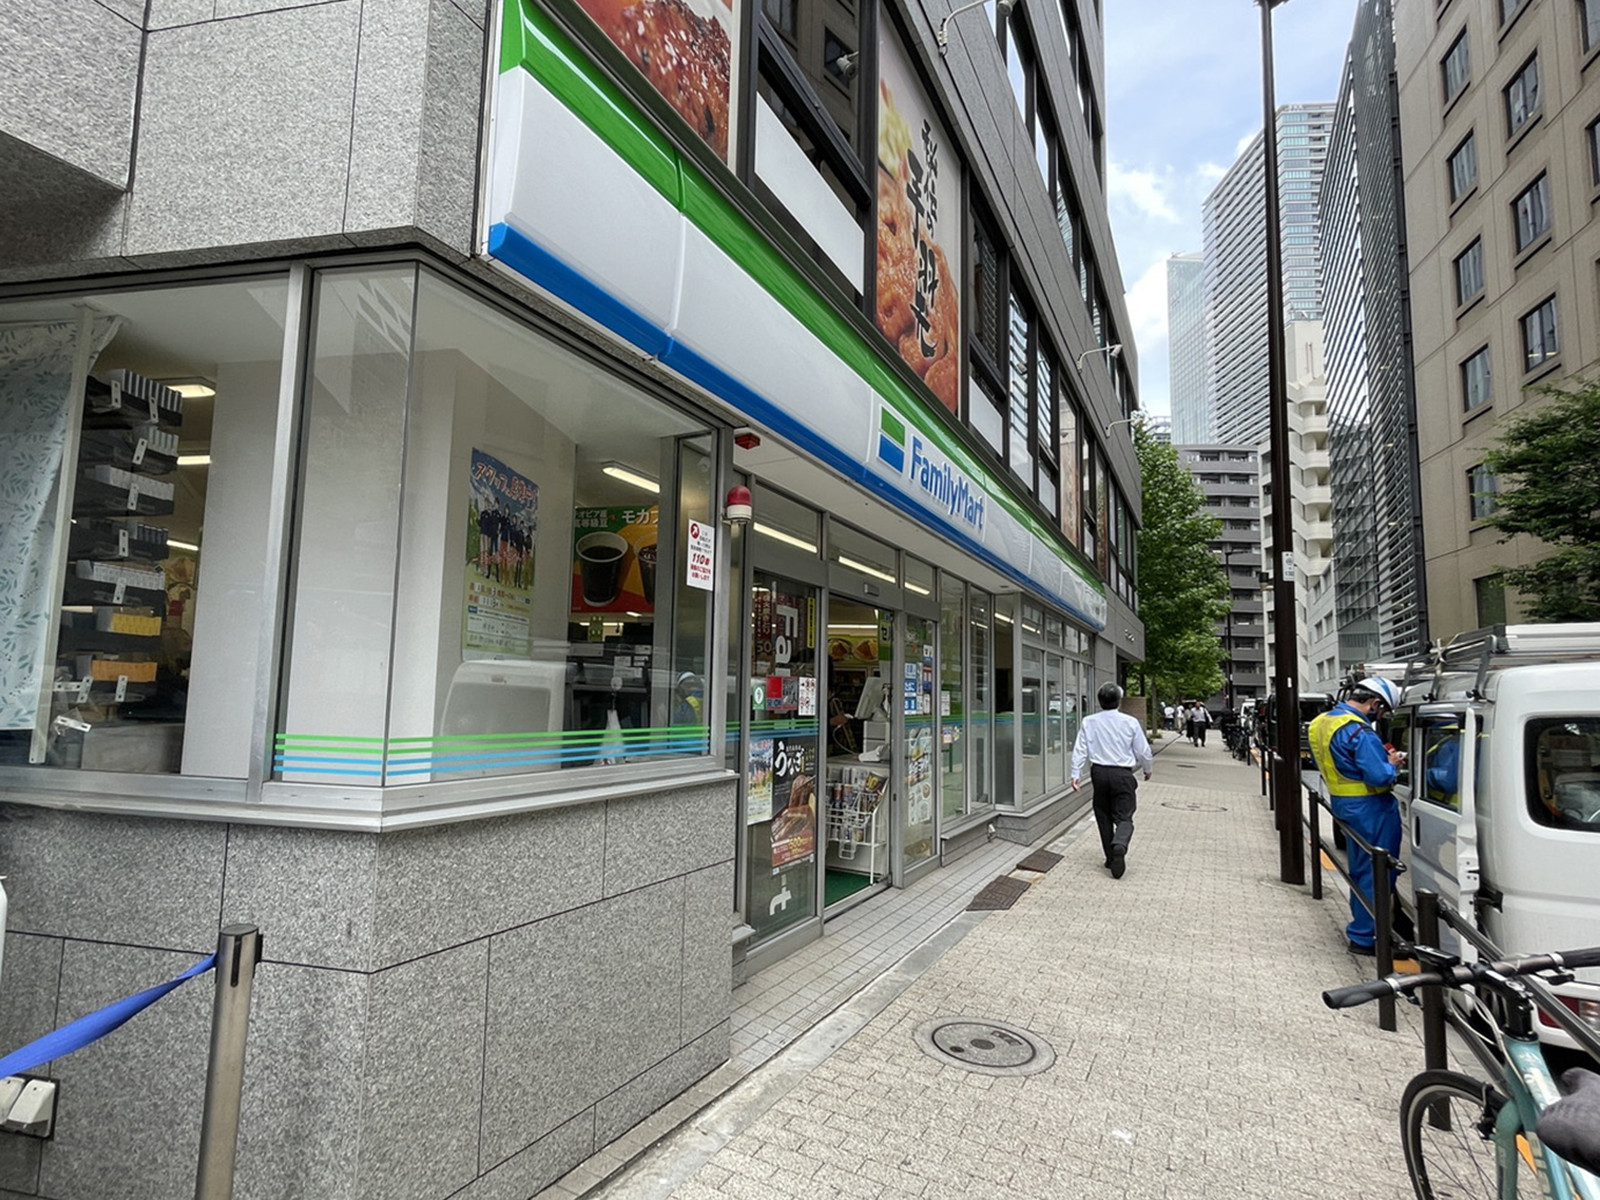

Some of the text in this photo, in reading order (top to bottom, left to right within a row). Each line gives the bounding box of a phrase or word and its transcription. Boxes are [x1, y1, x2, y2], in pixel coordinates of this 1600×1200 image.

[906, 148, 939, 358] 手羽先
[910, 434, 984, 531] FamilyMart
